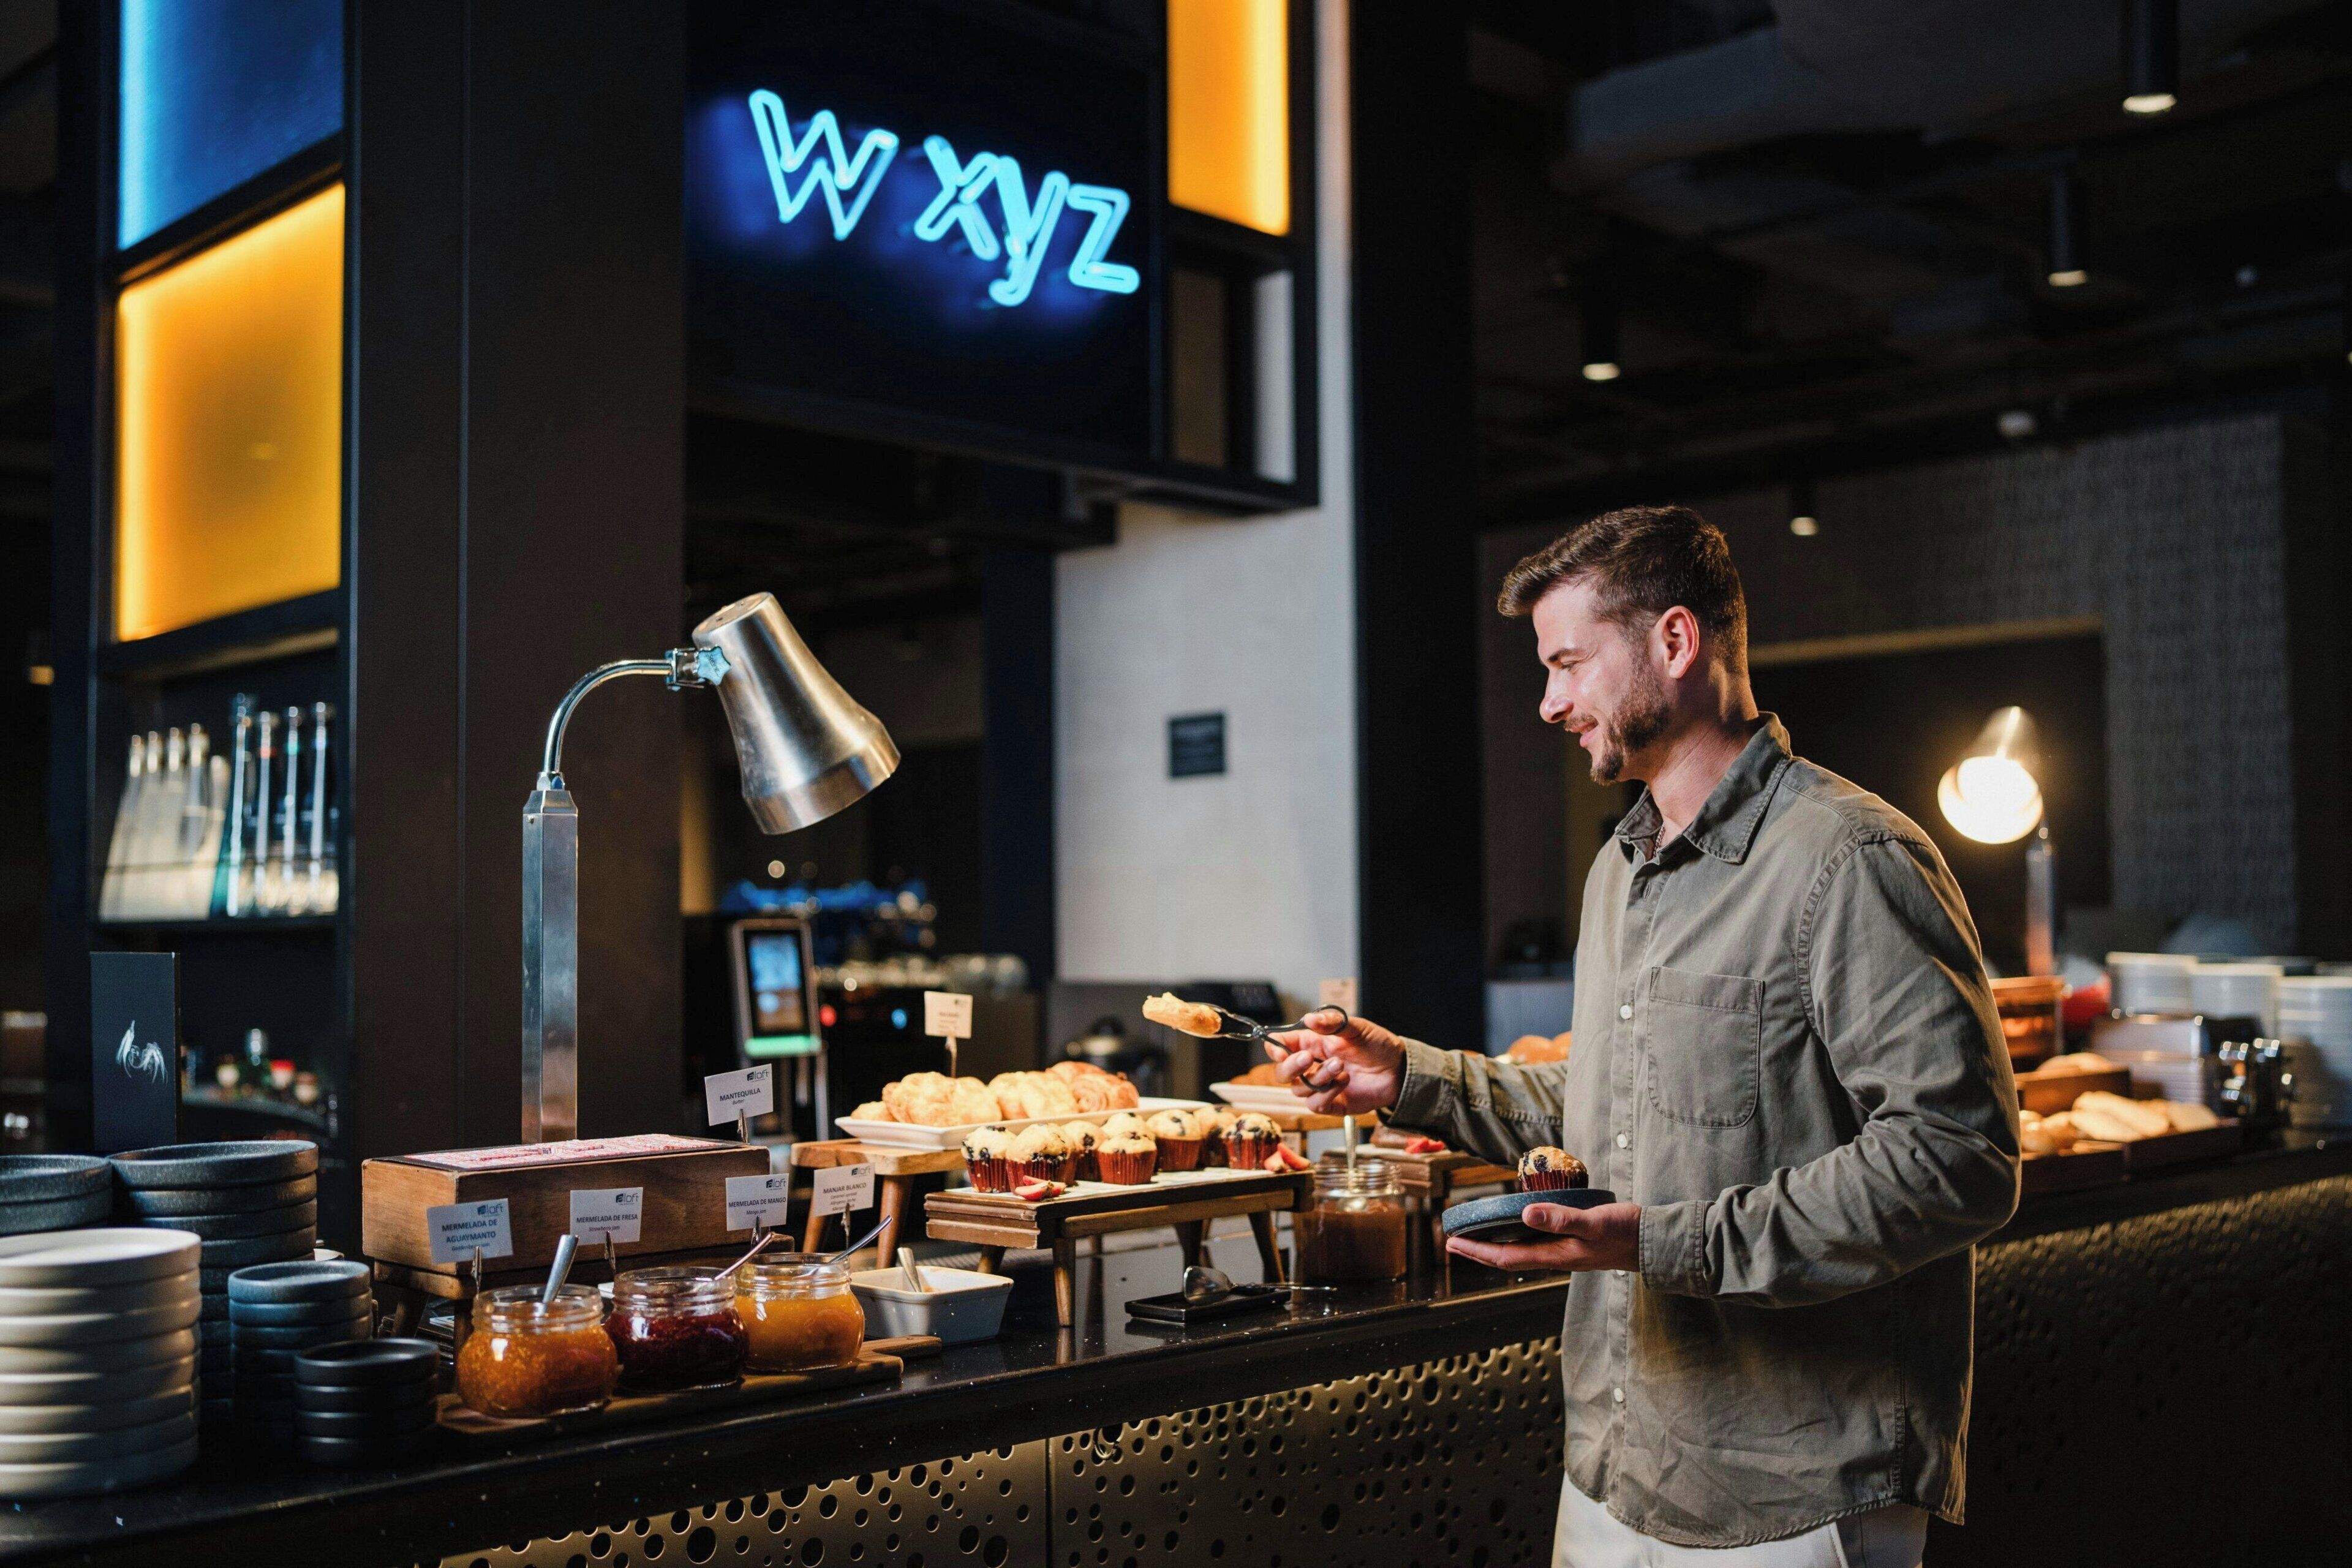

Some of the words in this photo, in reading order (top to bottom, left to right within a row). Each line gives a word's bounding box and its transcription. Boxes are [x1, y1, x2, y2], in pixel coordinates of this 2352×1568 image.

[913, 134, 1140, 307] xyz
[747, 1069, 769, 1081] aloft
[720, 1088, 761, 1101] MANTEQUILLA
[766, 1178, 786, 1188] aloft
[616, 1193, 639, 1203] aloft
[442, 1219, 487, 1232] MERMELADA
[446, 1231, 496, 1243] AGUAYMANTO
